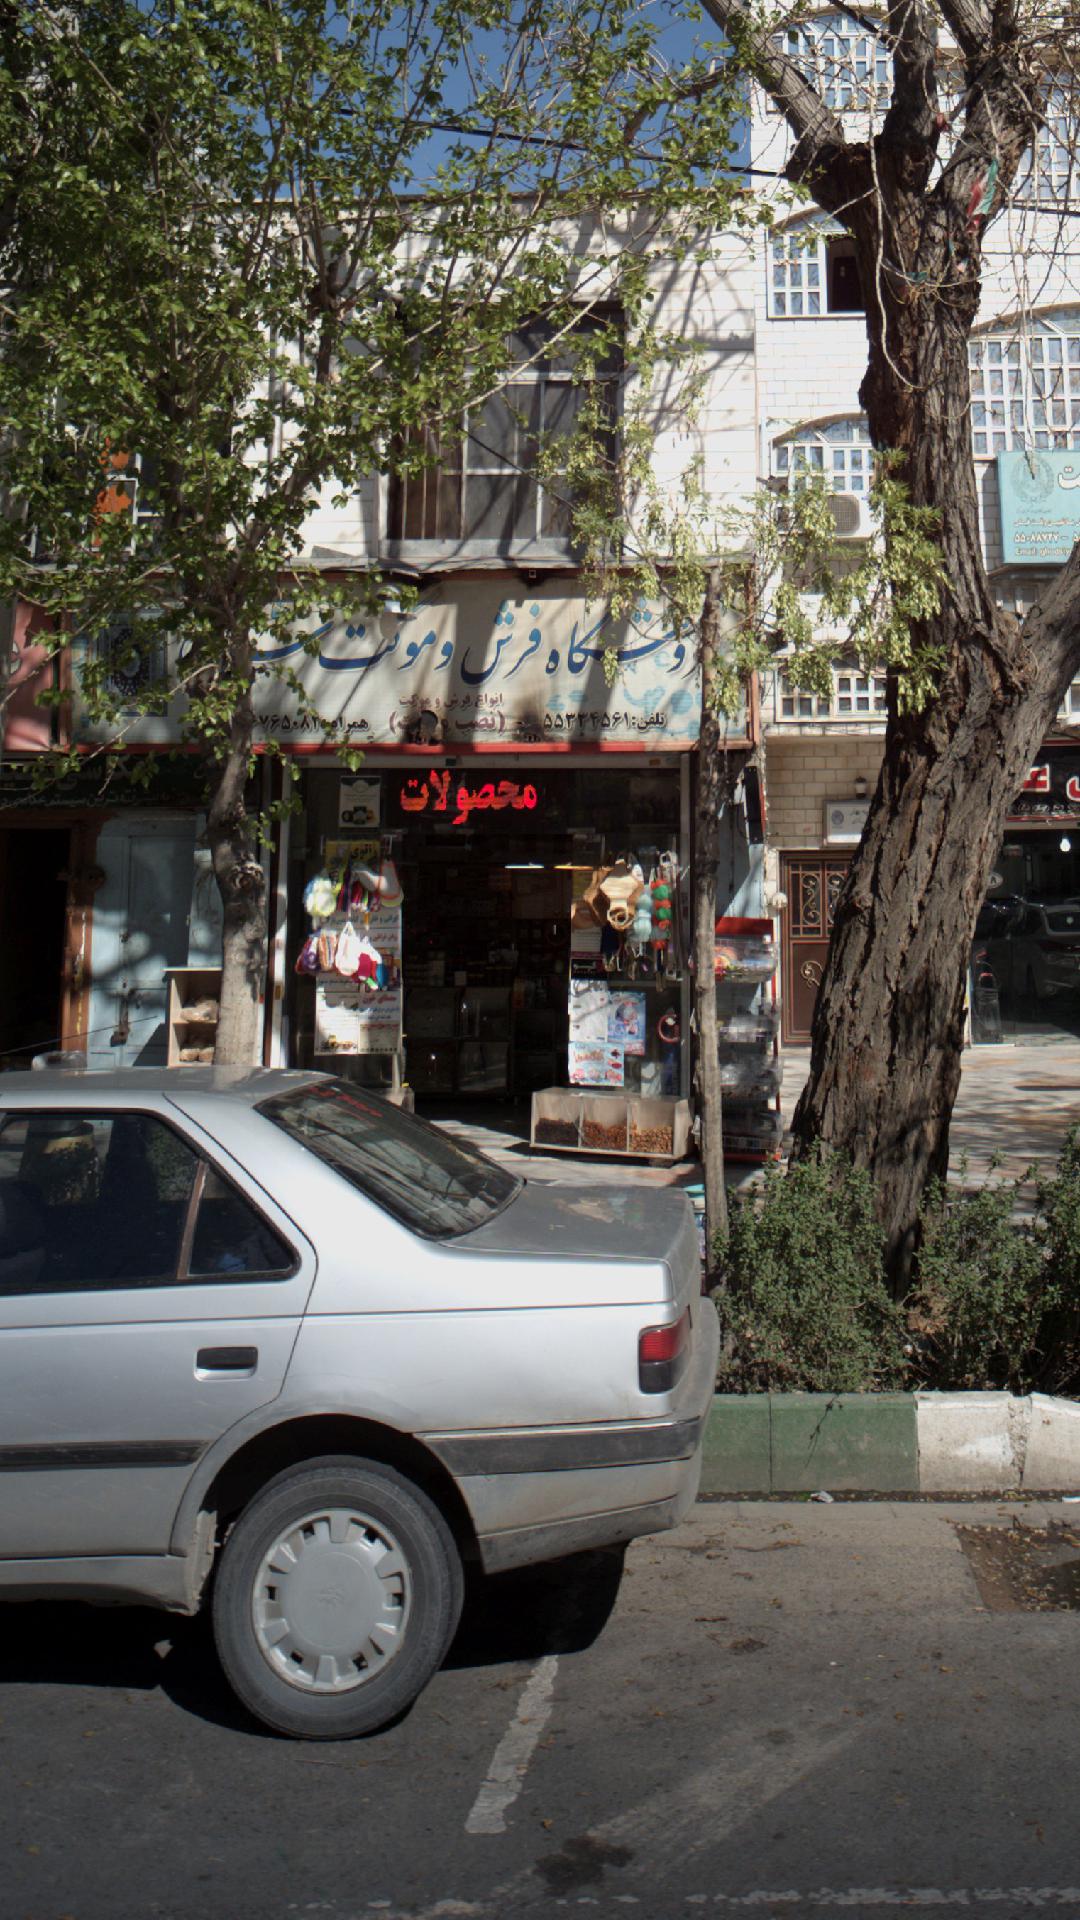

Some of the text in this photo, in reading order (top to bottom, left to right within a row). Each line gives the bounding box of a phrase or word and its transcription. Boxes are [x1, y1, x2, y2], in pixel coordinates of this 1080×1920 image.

[460, 600, 542, 685] فرش
[545, 598, 704, 681] وشگاه
[400, 769, 538, 825] محصولات
